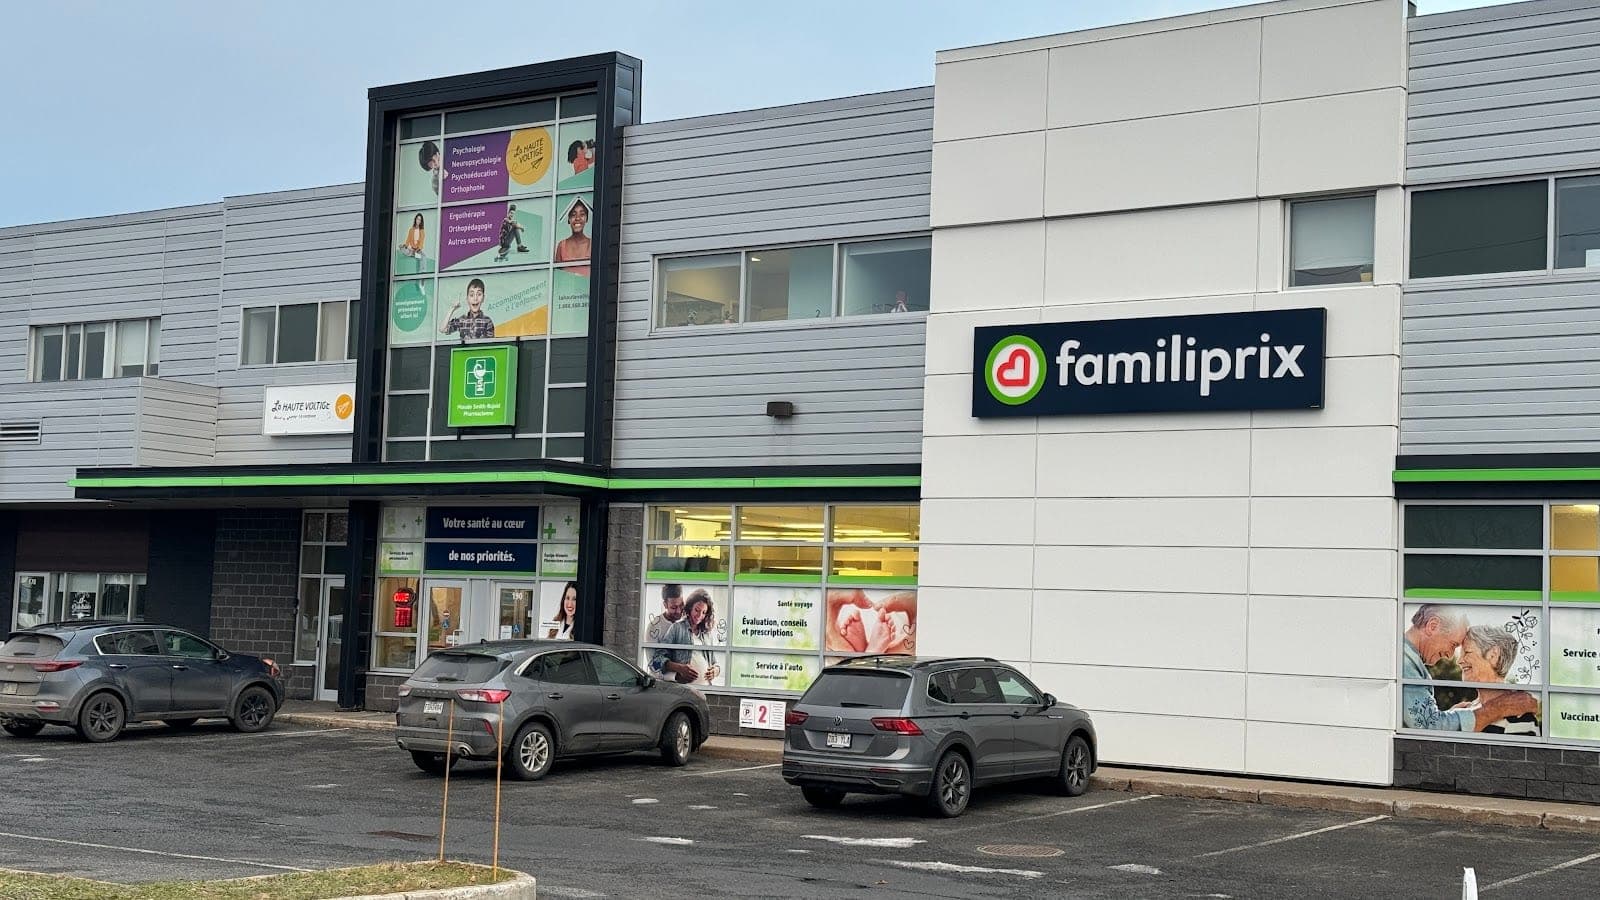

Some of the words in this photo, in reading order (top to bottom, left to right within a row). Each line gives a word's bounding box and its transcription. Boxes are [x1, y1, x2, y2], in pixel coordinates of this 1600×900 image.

[452, 144, 486, 155] Psychologie
[524, 137, 544, 152] HAUTE
[519, 147, 544, 164] VOLTIGE
[451, 156, 502, 168] Neuropsychologie
[451, 169, 498, 181] Psychoéducation
[450, 184, 485, 194] Orthophonie
[449, 209, 486, 221] Ergothérapie
[448, 222, 493, 233] Orthopédagogie
[448, 238, 467, 246] Autres
[467, 236, 491, 244] services
[1056, 334, 1306, 397] familiprix
[282, 403, 305, 412] HAUTE
[305, 401, 331, 411] VOLTIGE
[443, 517, 466, 529] Votre
[466, 517, 490, 529] santé
[491, 520, 503, 529] au
[503, 520, 526, 529] cœur
[448, 549, 459, 561] de
[460, 551, 475, 561] nos
[476, 550, 516, 564] priorités.
[742, 615, 779, 627] Évaluation,
[780, 619, 808, 627] conseils
[750, 628, 794, 638] prescriptions
[1563, 648, 1597, 658] Service
[756, 661, 778, 670] Service
[784, 662, 803, 671] l'auto
[758, 705, 768, 723] 2
[1560, 711, 1600, 722] Vaccinat
